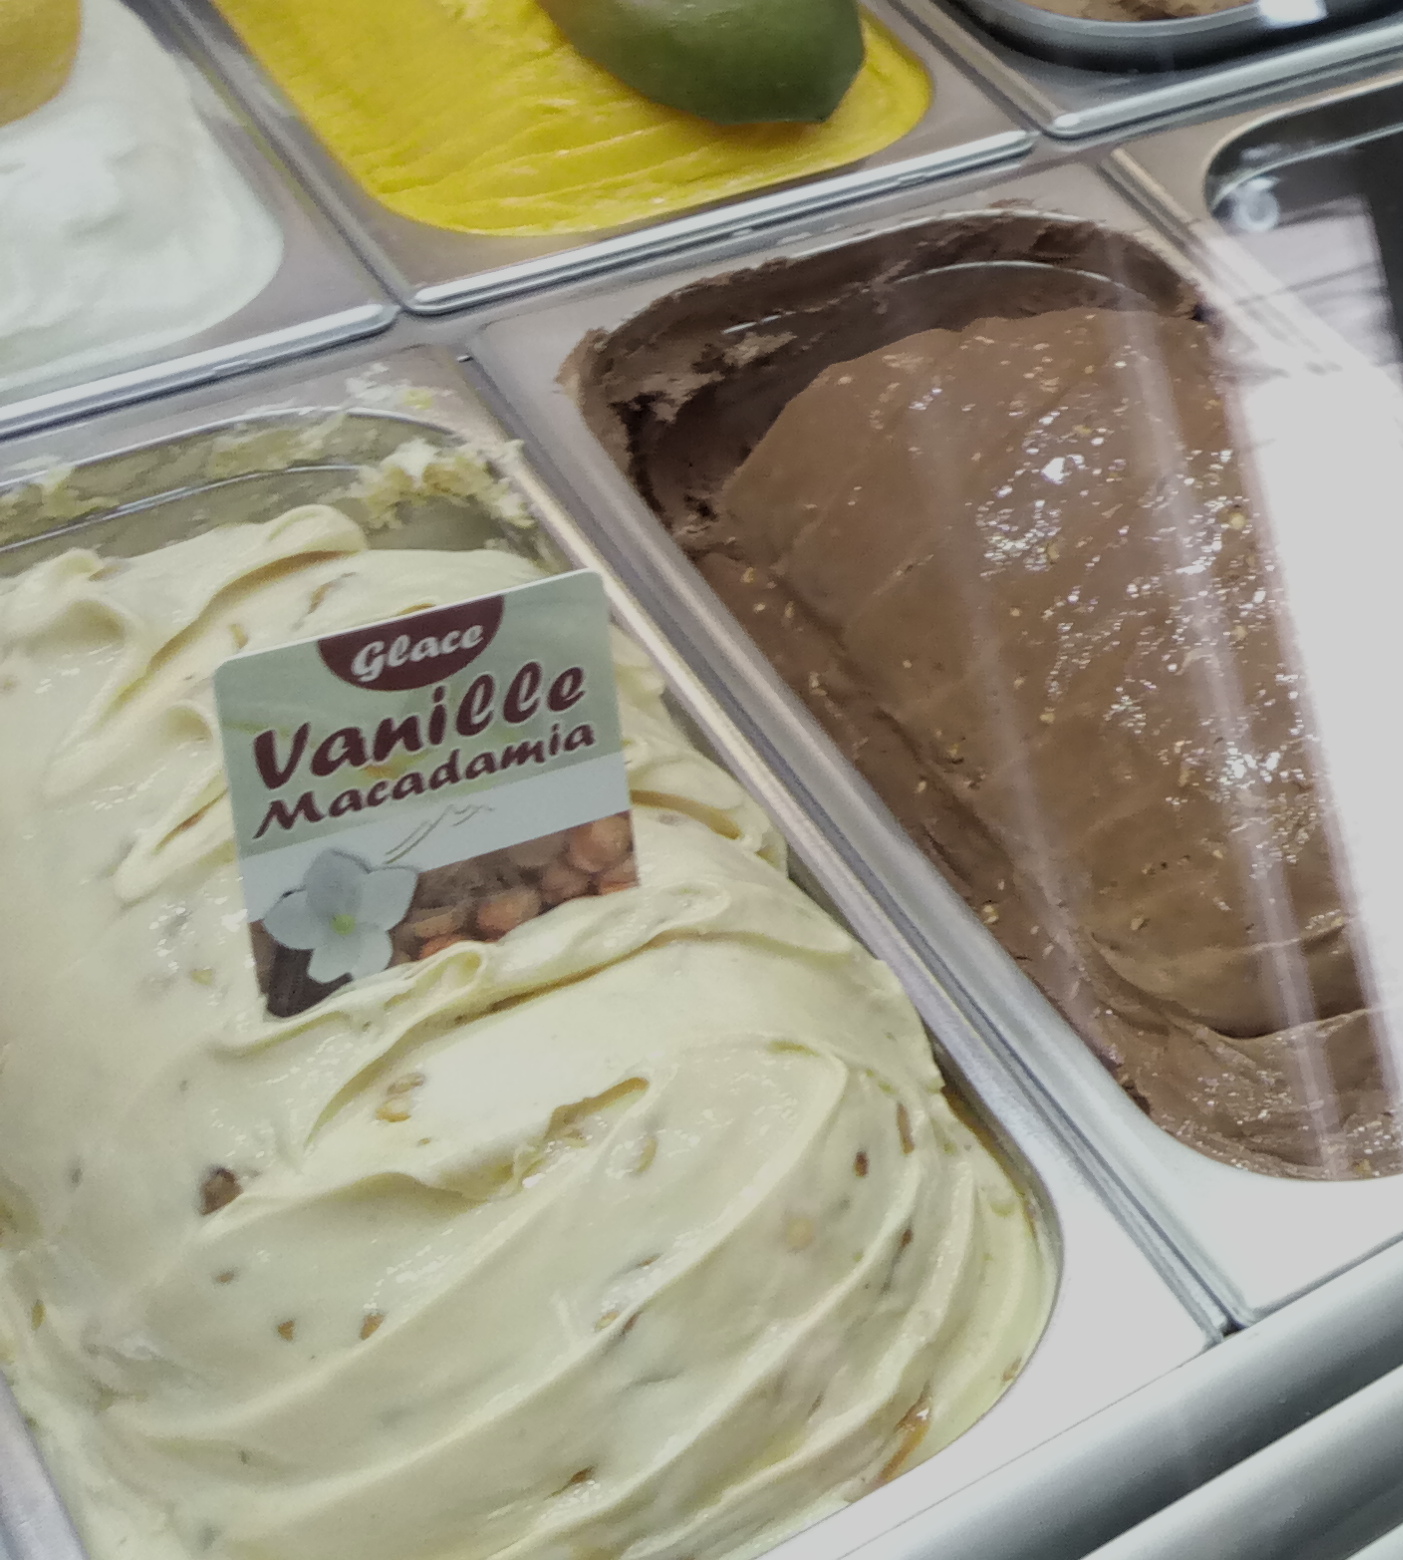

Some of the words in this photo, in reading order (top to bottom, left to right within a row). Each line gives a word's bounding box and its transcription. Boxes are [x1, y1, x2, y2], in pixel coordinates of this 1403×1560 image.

[351, 624, 484, 682] Glace
[252, 723, 597, 839] Macadamia
[253, 661, 586, 789] Vanille
